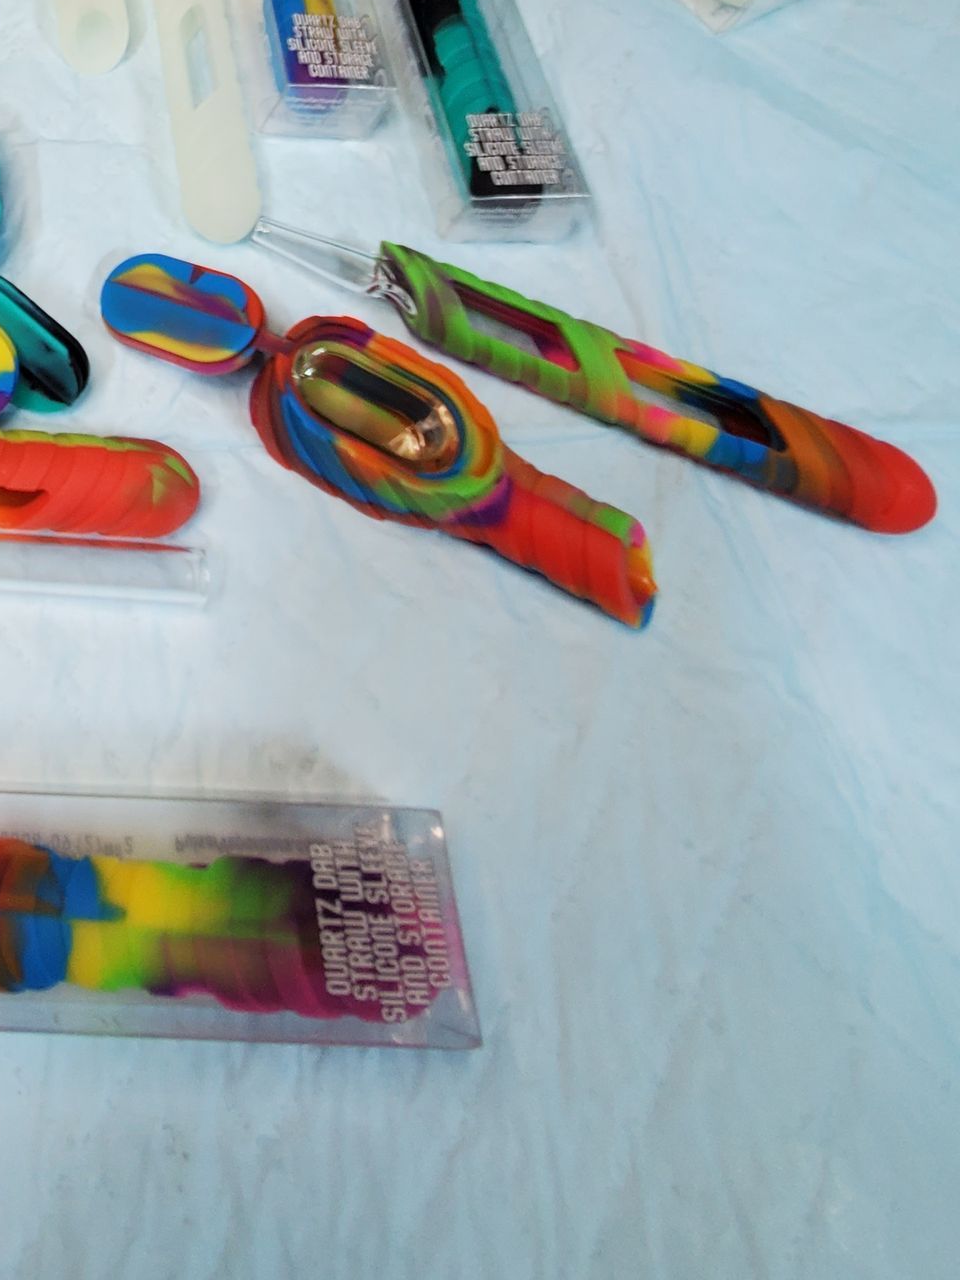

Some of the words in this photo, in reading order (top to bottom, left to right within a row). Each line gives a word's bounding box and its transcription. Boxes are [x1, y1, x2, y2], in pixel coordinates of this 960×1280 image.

[310, 843, 339, 890] DAB
[333, 840, 365, 902] WITH
[355, 825, 389, 904] SLEEVE
[383, 840, 421, 946] STORAGE
[315, 898, 352, 996] QUARTZ
[342, 909, 378, 1001] STRAW
[367, 913, 407, 1022] SILICONE
[408, 859, 452, 988] CONTAINER
[399, 954, 431, 1006] AND
